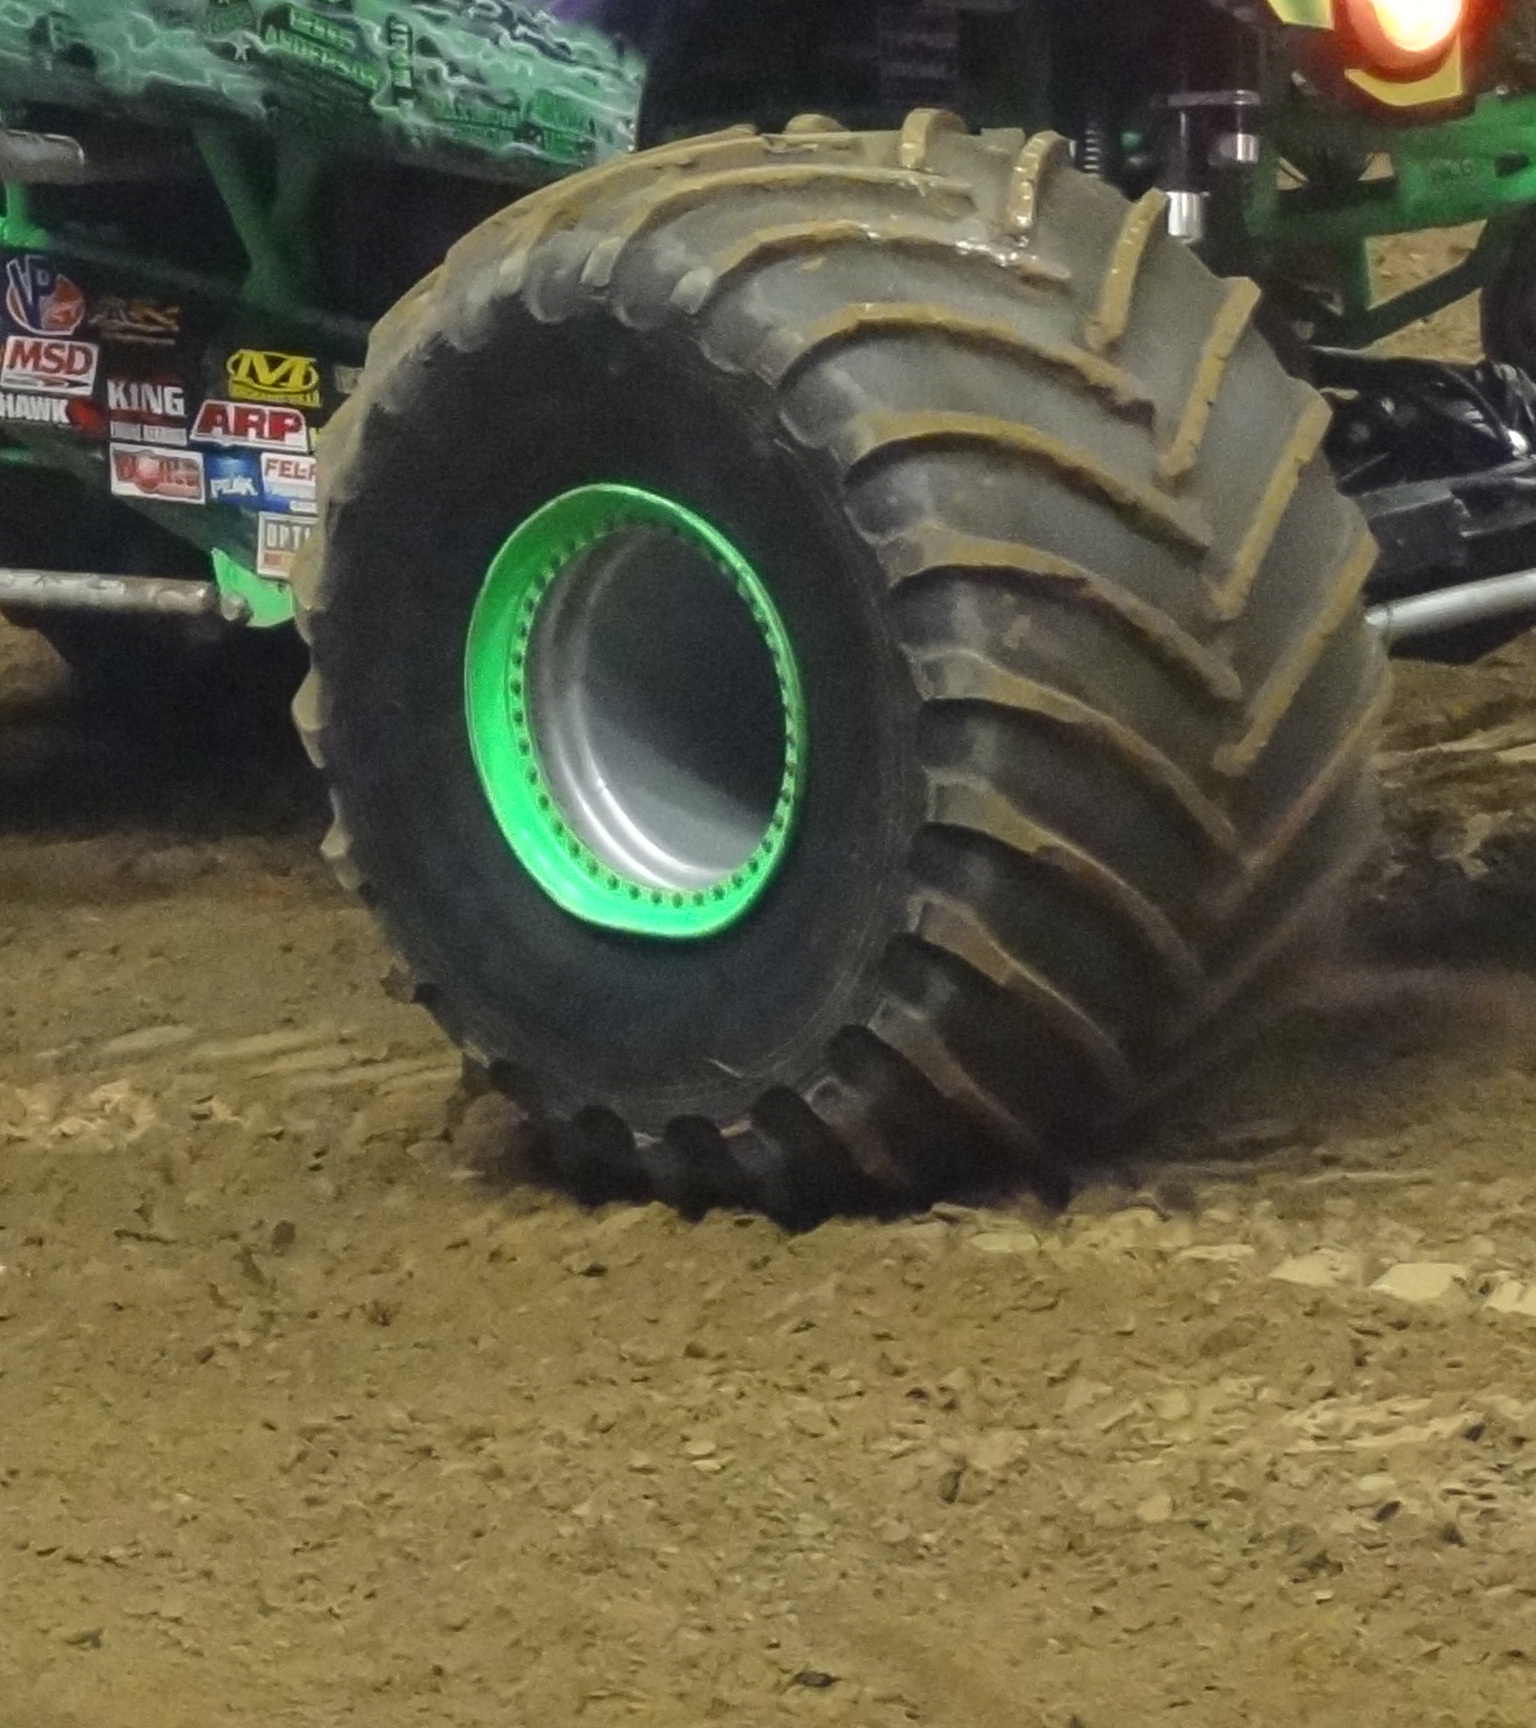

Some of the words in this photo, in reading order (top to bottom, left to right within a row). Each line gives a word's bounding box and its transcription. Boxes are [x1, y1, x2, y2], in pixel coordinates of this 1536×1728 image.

[8, 339, 93, 376] MSD
[107, 379, 186, 416] KING
[196, 401, 303, 442] ARP
